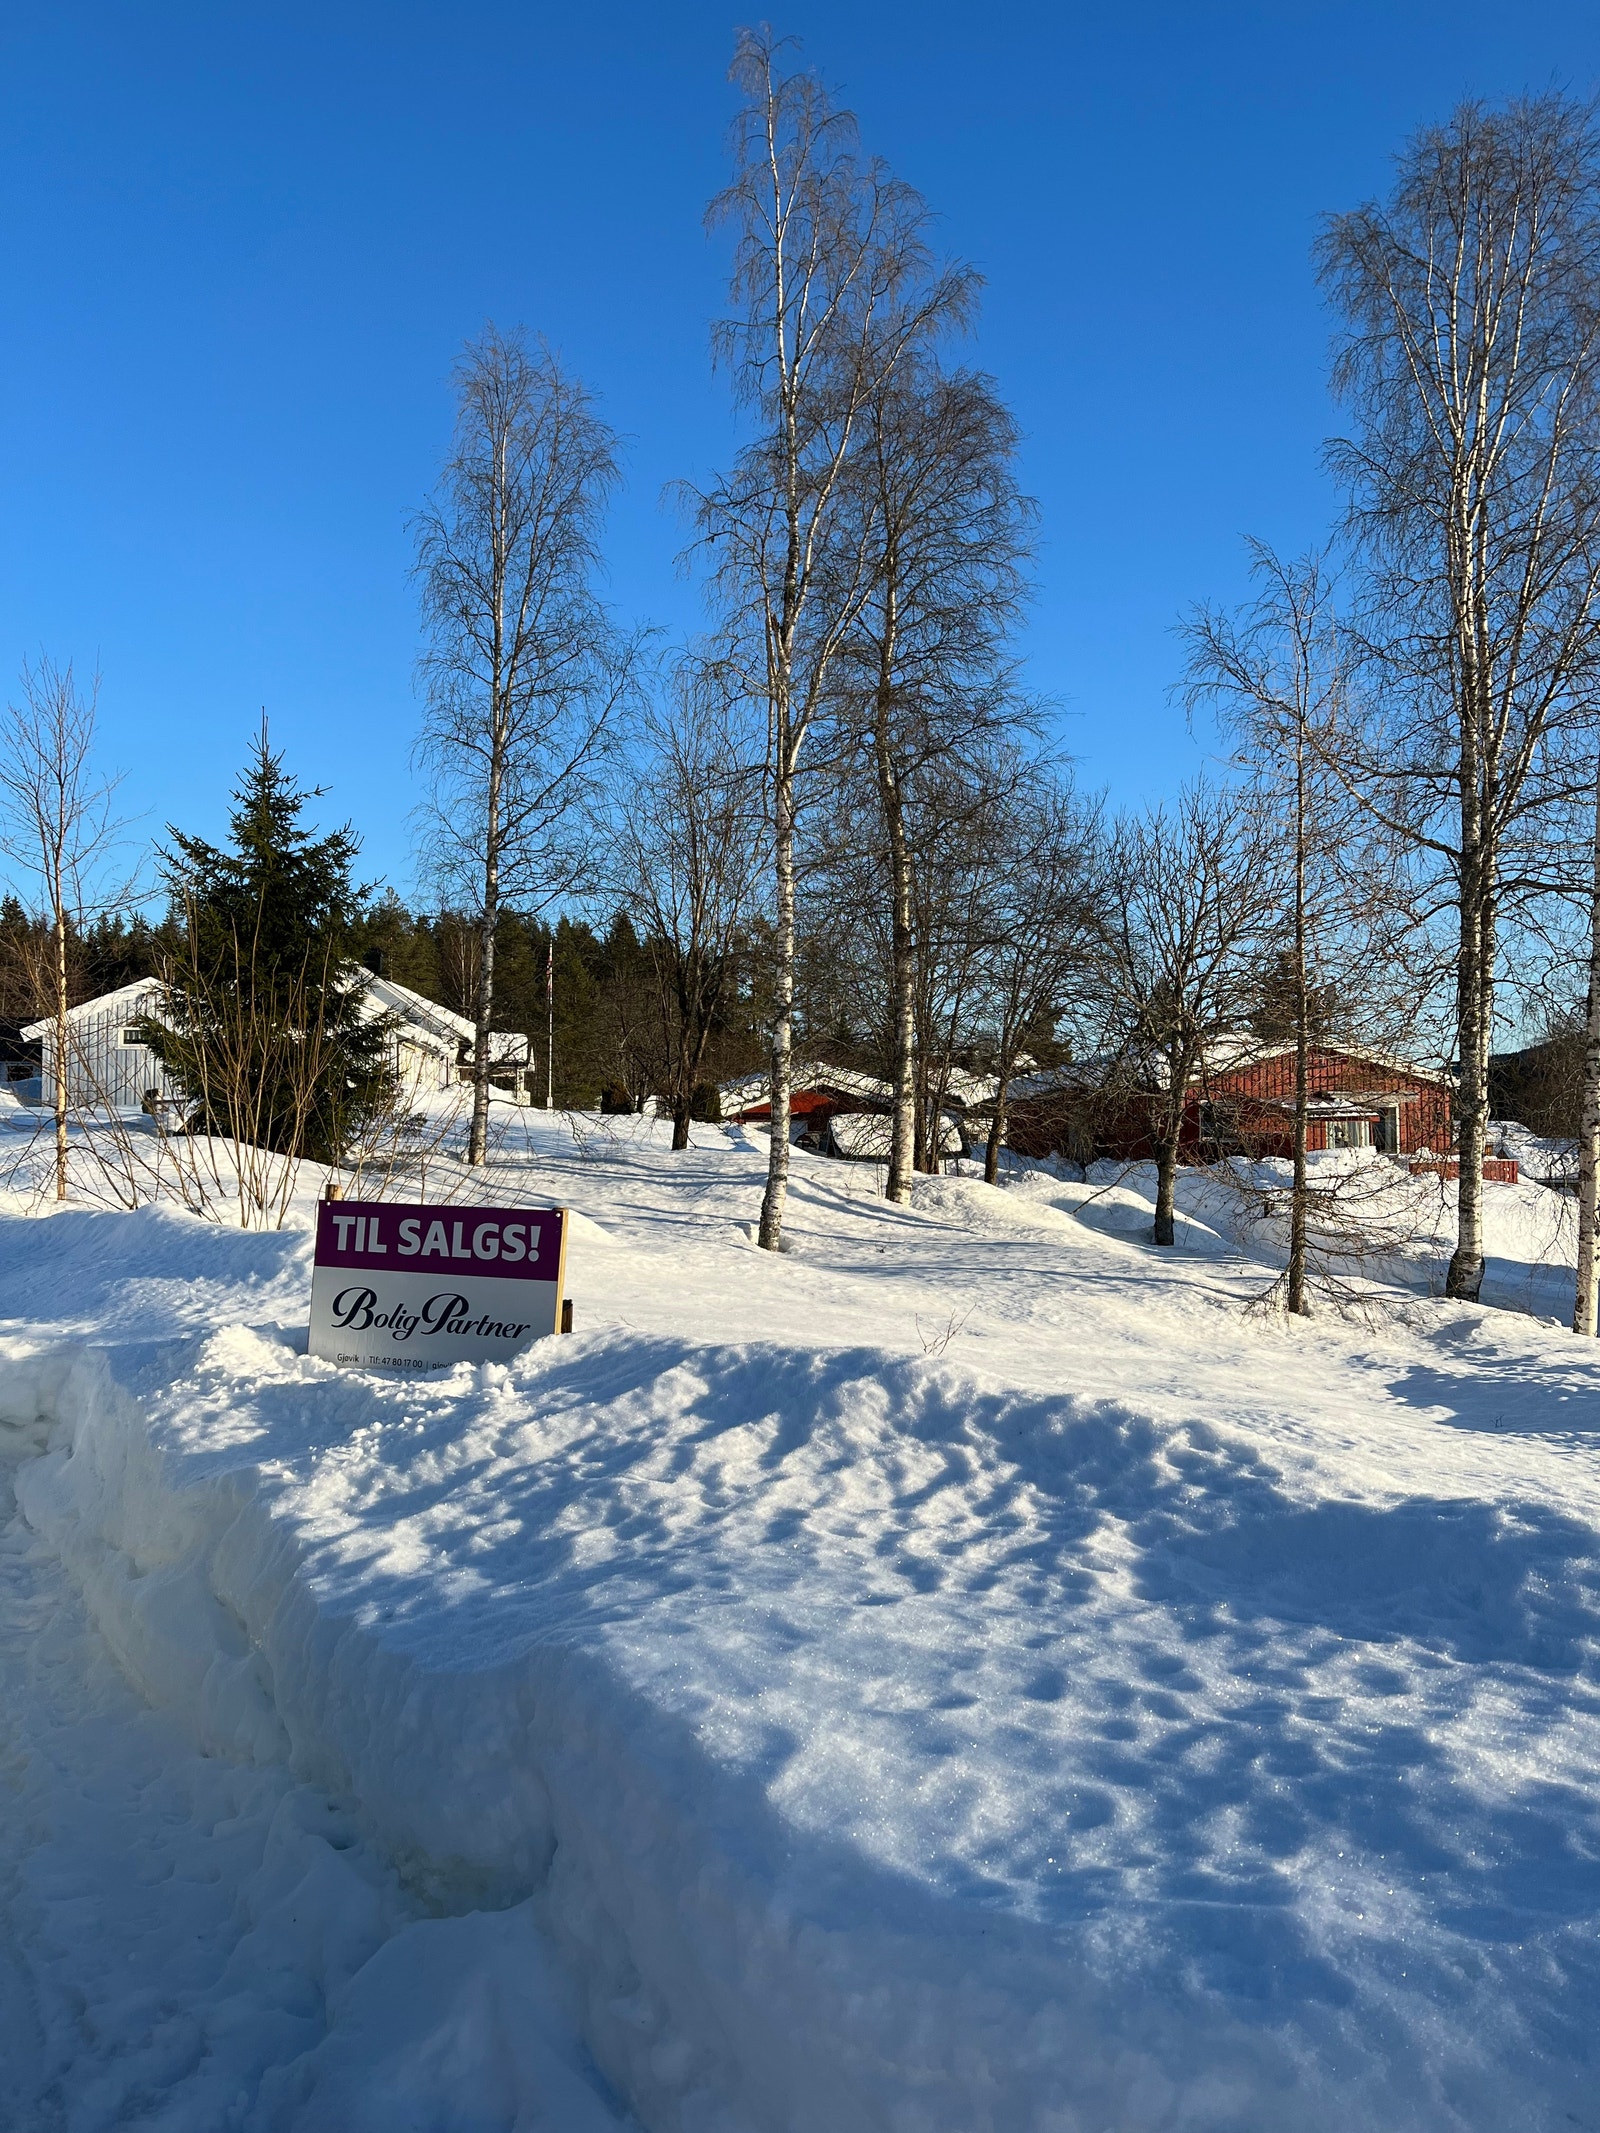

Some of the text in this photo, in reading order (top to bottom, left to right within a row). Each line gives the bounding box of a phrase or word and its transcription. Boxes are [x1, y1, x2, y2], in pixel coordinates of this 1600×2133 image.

[332, 1215, 542, 1262] TIL SALGS!
[331, 1286, 531, 1341] BoligPartner
[337, 1353, 360, 1363] Gjøvik
[369, 1356, 381, 1365] Tlf:
[382, 1357, 391, 1365] 47
[392, 1358, 402, 1366] 80
[404, 1359, 411, 1367] 17
[412, 1359, 423, 1368] 00
